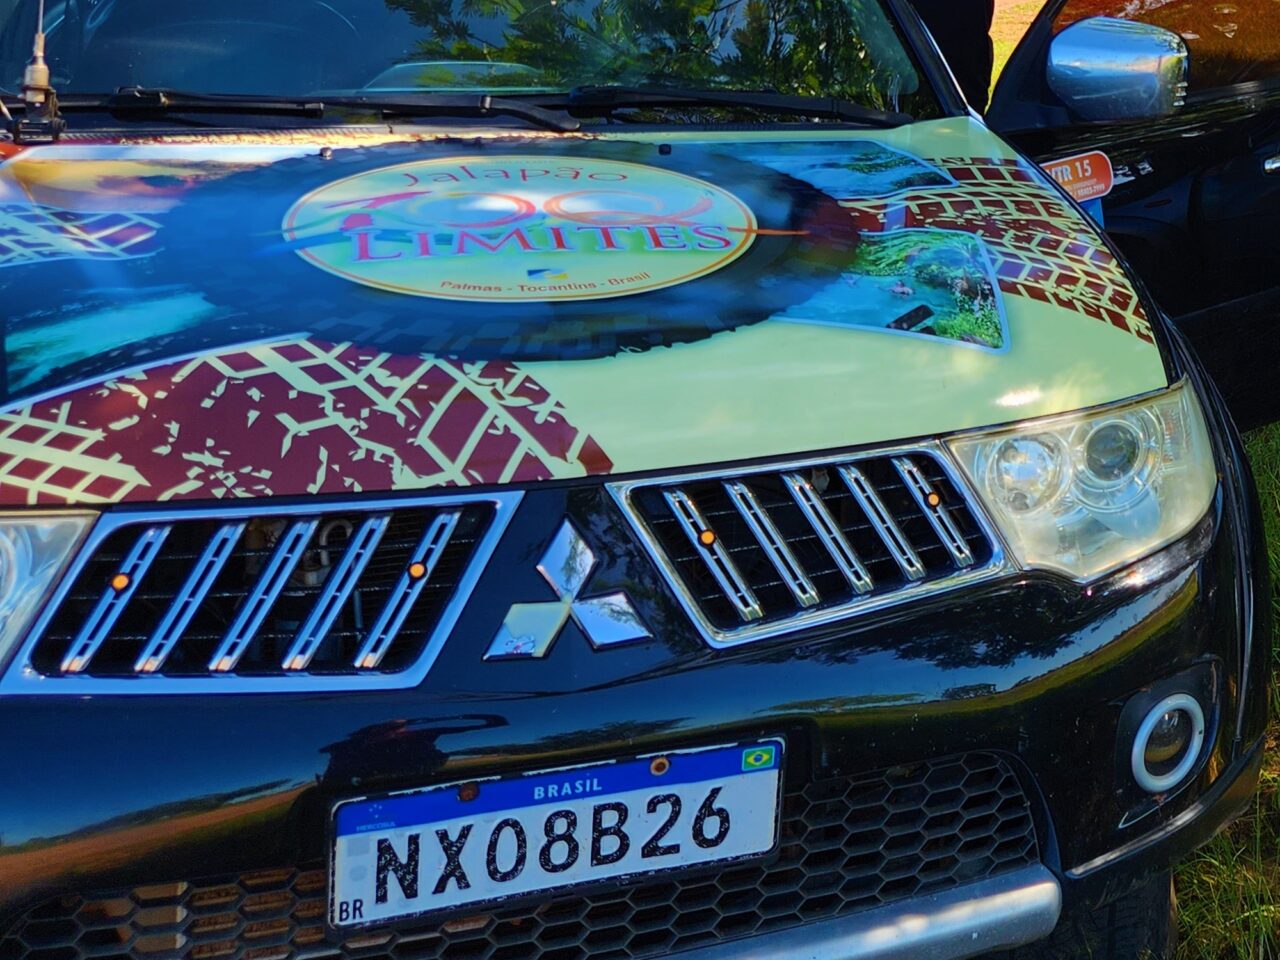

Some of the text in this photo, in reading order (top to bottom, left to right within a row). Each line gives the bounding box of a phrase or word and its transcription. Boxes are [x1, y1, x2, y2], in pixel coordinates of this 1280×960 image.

[404, 164, 629, 188] Jalapão
[1075, 159, 1092, 178] 15
[347, 224, 734, 263] LIMITES
[441, 280, 503, 292] Palmas
[517, 280, 596, 293] Tocantins
[609, 271, 650, 287] Brasil
[533, 777, 603, 801] BRASIL
[339, 898, 364, 923] BR
